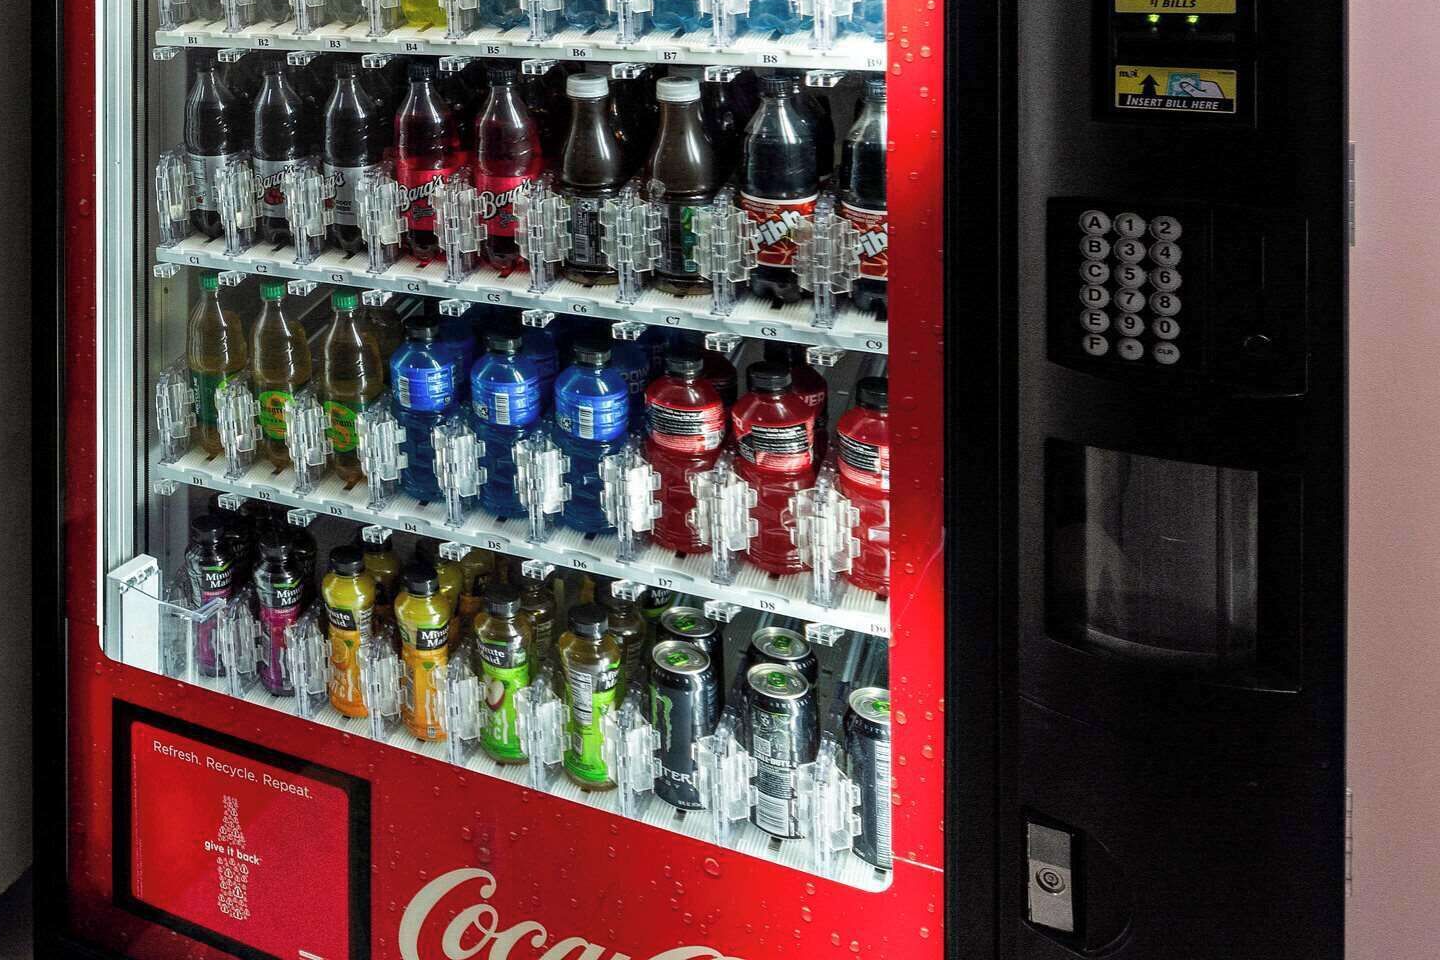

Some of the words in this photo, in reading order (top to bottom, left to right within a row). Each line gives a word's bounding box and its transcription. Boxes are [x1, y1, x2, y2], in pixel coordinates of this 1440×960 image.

[1162, 0, 1197, 8] BILLS
[188, 36, 198, 44] B1
[258, 38, 269, 47] B2
[330, 40, 341, 49] B3
[406, 42, 418, 51] B4
[487, 46, 500, 55] B5
[572, 48, 586, 58] B6
[663, 51, 677, 61] B7
[763, 54, 778, 64] B8
[1126, 94, 1163, 107] INSERT
[1166, 99, 1189, 108] BILL
[1191, 100, 1220, 110] HERE
[397, 174, 445, 212] Barq's
[1088, 216, 1102, 229] A
[1125, 219, 1133, 231] 1
[1160, 222, 1171, 234] 2
[1089, 241, 1101, 253] B
[1125, 243, 1135, 256] 3
[1160, 246, 1171, 259] 4
[189, 256, 200, 265] C1
[256, 264, 268, 273] C2
[331, 273, 343, 282] C3
[1088, 265, 1102, 277] C
[1124, 268, 1135, 280] 5
[1160, 271, 1170, 284] 6
[407, 283, 420, 292] C4
[487, 293, 500, 303] C5
[1089, 289, 1102, 301] D
[1124, 292, 1135, 305] 7
[1160, 296, 1170, 308] 8
[572, 303, 587, 313] C6
[665, 316, 681, 326] C7
[1089, 313, 1101, 326] E
[1124, 316, 1135, 329] 9
[1160, 320, 1171, 334] 0
[761, 327, 777, 337] C8
[866, 340, 882, 350] C9
[1089, 337, 1100, 349] F
[193, 477, 203, 486] D1
[259, 491, 271, 500] D2
[330, 506, 342, 515] D3
[404, 523, 417, 532] D4
[488, 541, 501, 551] D5
[573, 559, 587, 569] D6
[658, 577, 673, 588] D7
[760, 600, 775, 611] D8
[153, 740, 202, 766] Refresh.
[207, 756, 258, 783] Recycle.
[263, 773, 313, 799] Repeat.
[204, 840, 225, 853] give
[227, 845, 234, 856] it
[237, 848, 260, 865] back
